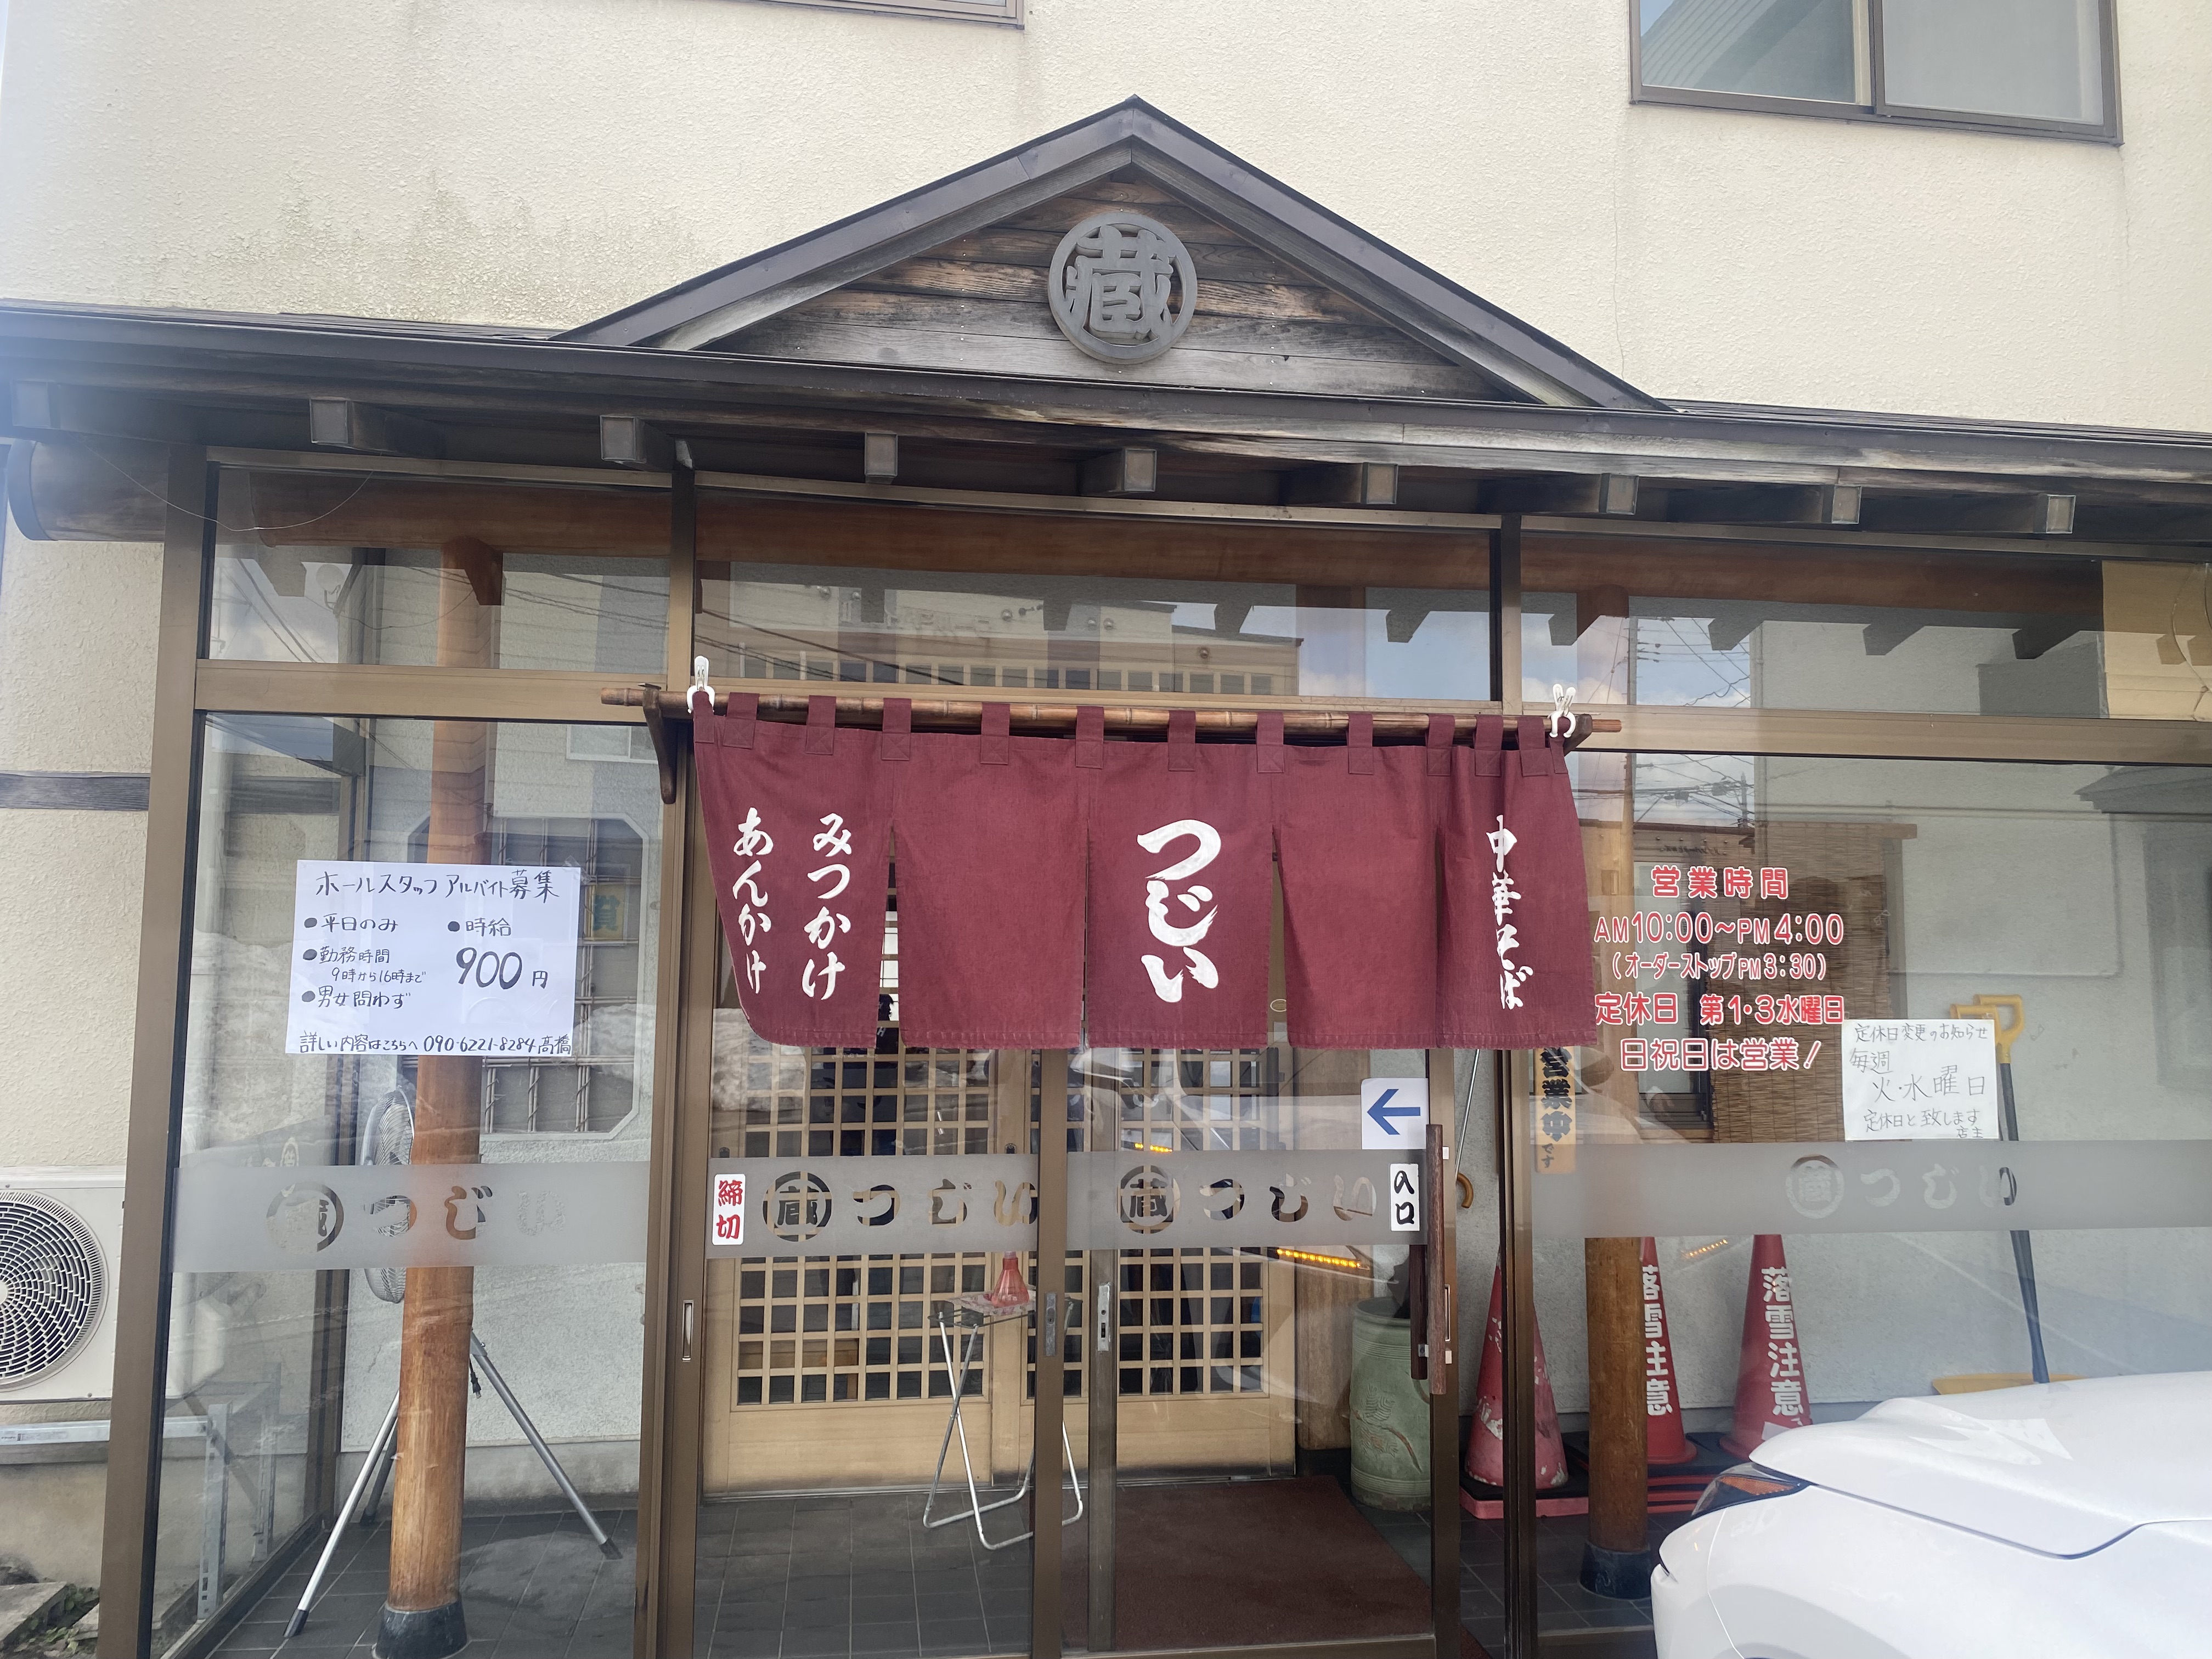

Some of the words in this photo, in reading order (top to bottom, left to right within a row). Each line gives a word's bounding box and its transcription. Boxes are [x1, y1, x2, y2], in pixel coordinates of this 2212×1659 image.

[315, 871, 437, 895] ホールスタッフ
[445, 870, 560, 904] アルバイト募集
[1650, 865, 1790, 899] 営業時間
[732, 807, 774, 994] あんかけ
[802, 812, 853, 1001] みつかけ
[1137, 819, 1222, 1003] つじい
[1486, 815, 1534, 1010] 中華そば
[321, 912, 399, 933] 平日のみ
[465, 917, 511, 937] 時給
[319, 946, 390, 964] 勤務時間
[331, 967, 426, 984] 9時から16時まで
[318, 985, 411, 1009] 男女問わず
[1594, 991, 1679, 1025] 定休日
[300, 1030, 418, 1053] 詳しい内容はこちらへ
[424, 1035, 537, 1053] 090-6221-8284
[1855, 1023, 1988, 1042] 定休日変更のお知らせ
[1849, 1048, 1893, 1074] 毎週
[1864, 1108, 1980, 1132] 定休日と致します
[1956, 1125, 1983, 1138] 店主
[716, 1180, 743, 1239] 締切
[1394, 1170, 1415, 1225] 入口
[1761, 1266, 1804, 1416] 落雪注意
